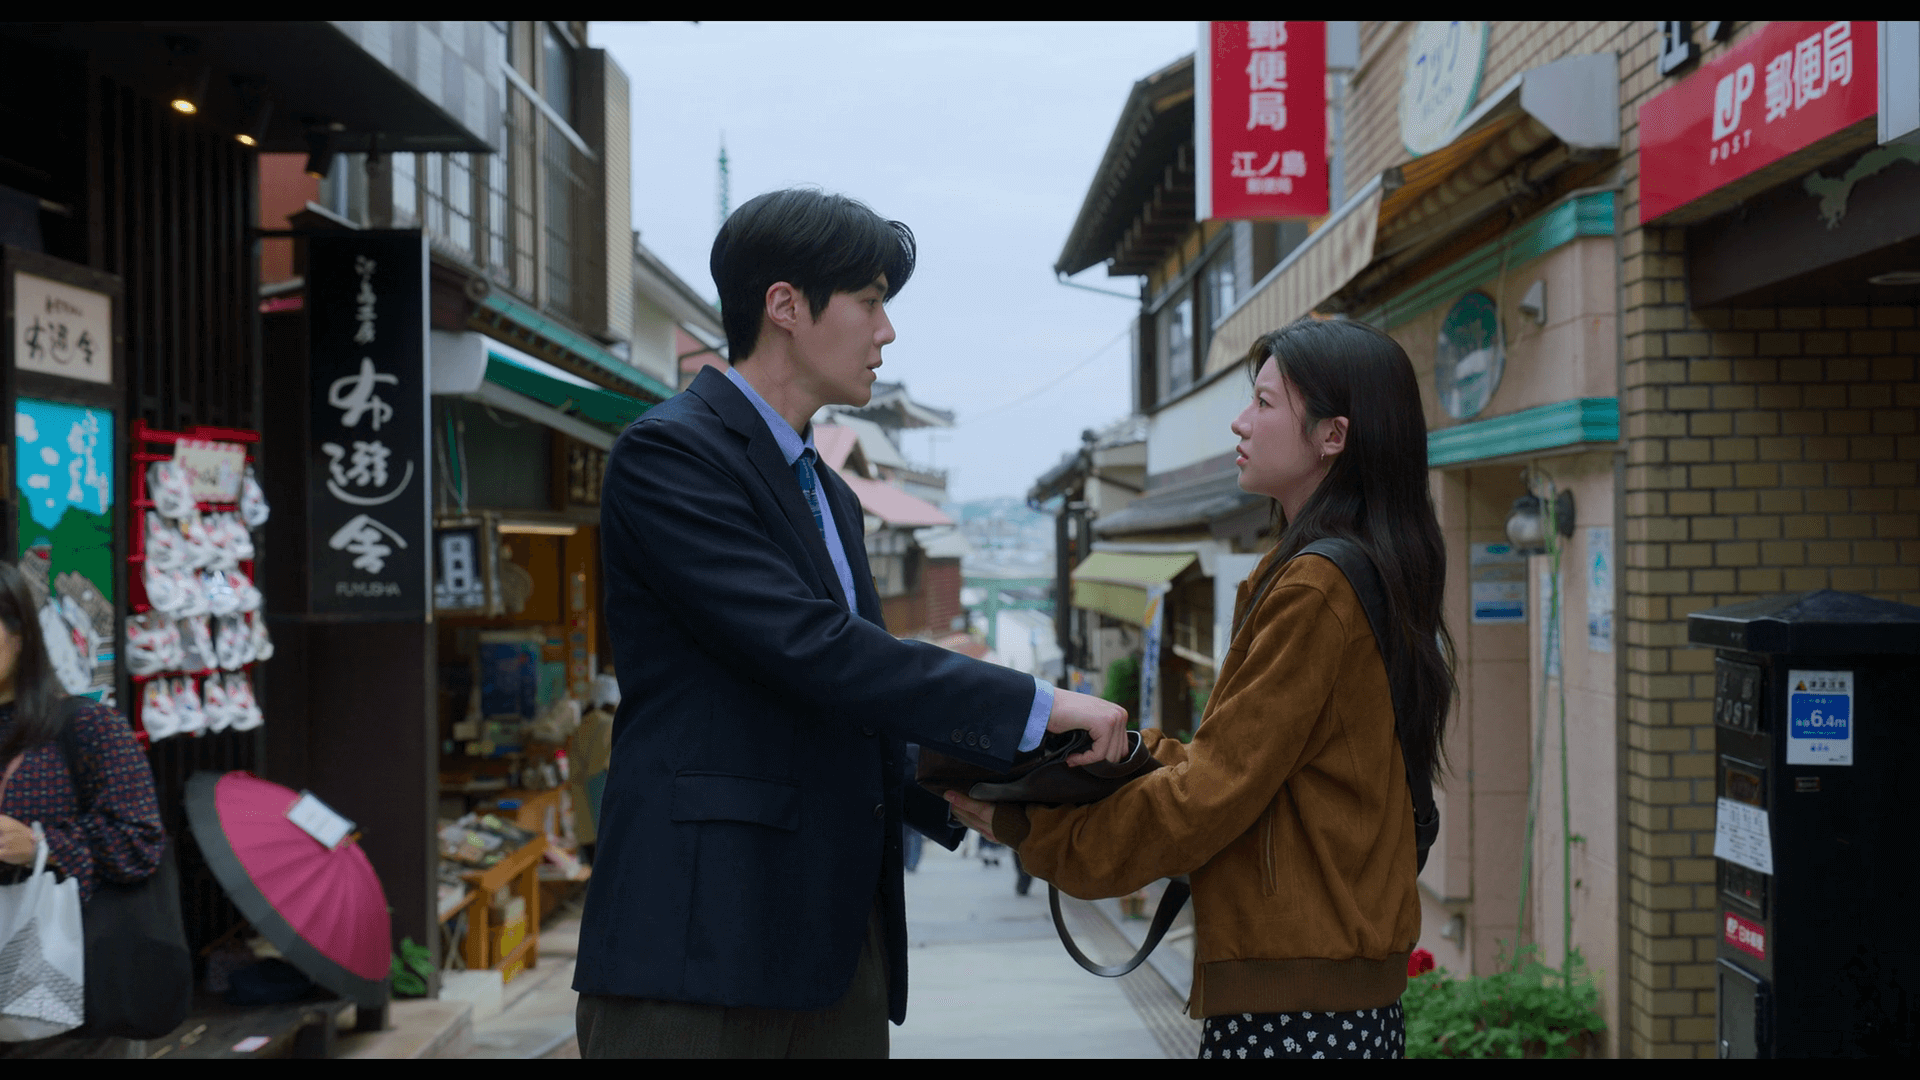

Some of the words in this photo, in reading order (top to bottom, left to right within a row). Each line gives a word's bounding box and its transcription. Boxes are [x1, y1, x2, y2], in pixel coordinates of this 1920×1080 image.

[1246, 21, 1288, 131] 郵便局
[1765, 20, 1854, 124] 郵便局
[1231, 150, 1307, 177] 江ノ島
[1709, 128, 1753, 166] POST
